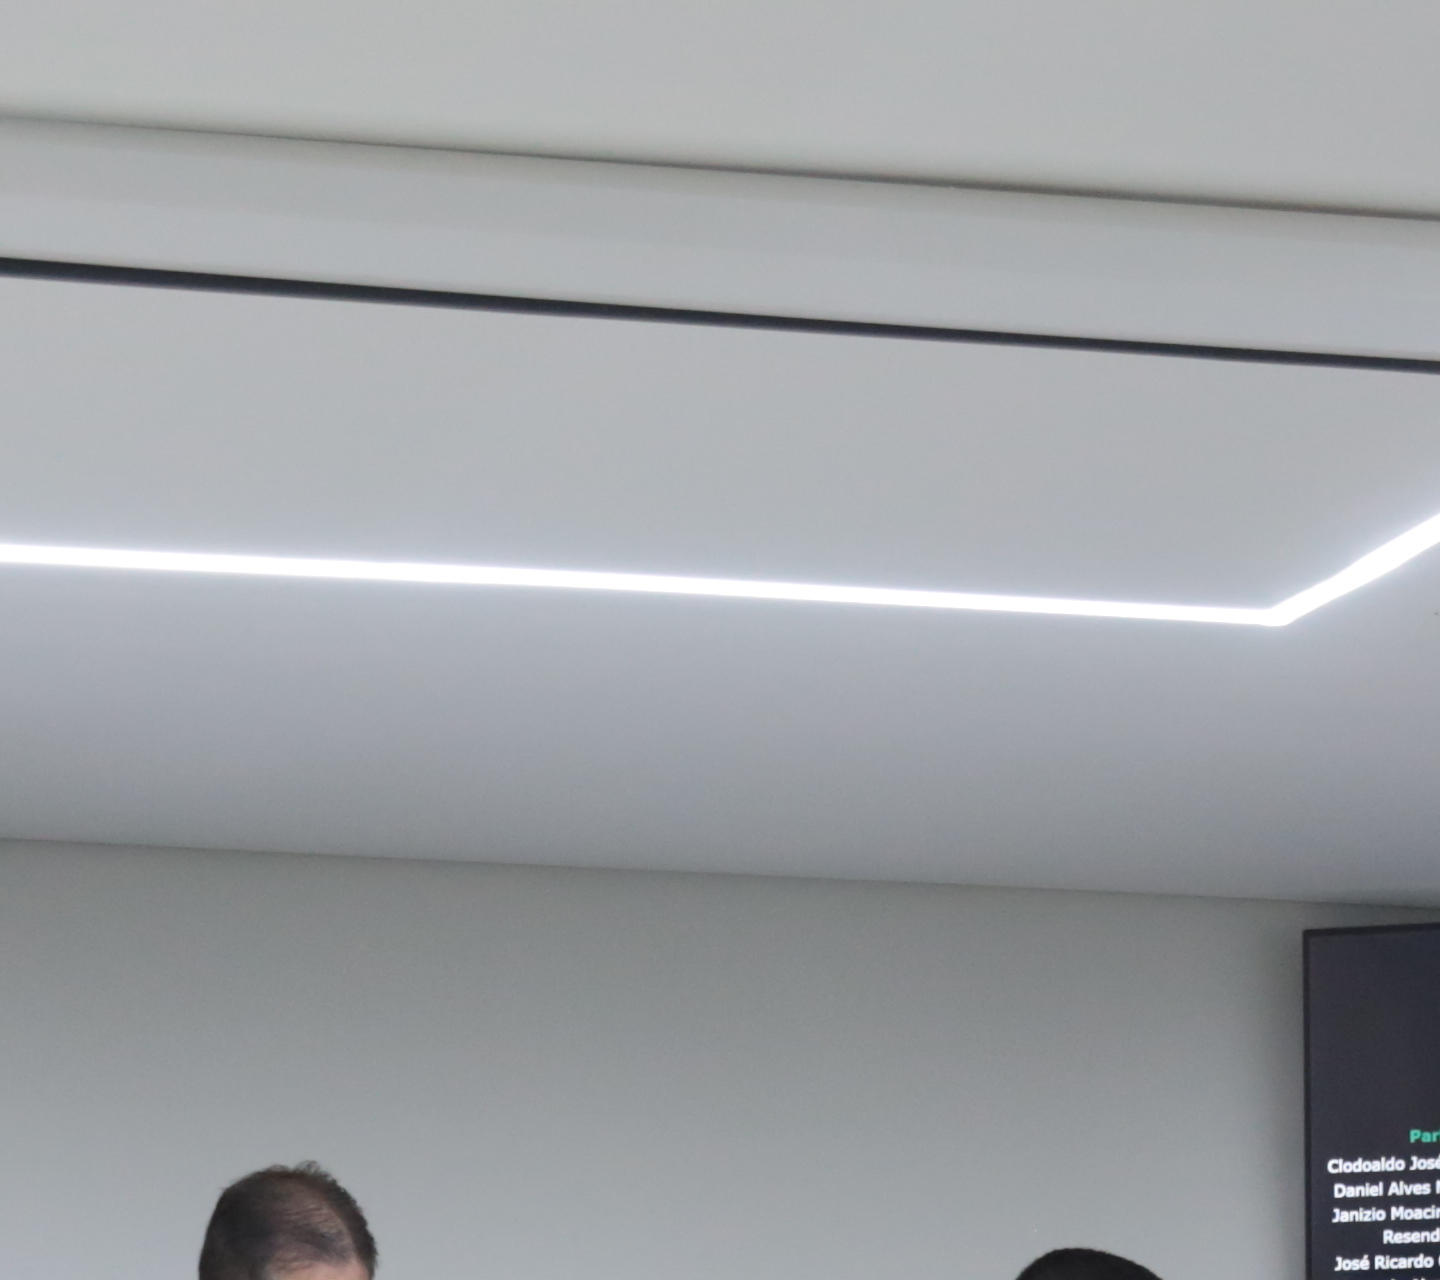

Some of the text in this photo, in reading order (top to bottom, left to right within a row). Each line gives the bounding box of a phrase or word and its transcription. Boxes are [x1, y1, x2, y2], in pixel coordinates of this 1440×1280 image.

[1327, 1157, 1405, 1173] Clodoaldo
[1334, 1182, 1383, 1198] Daniel
[1388, 1181, 1431, 1196] Alves
[1332, 1207, 1386, 1223] Janizio
[1335, 1255, 1370, 1271] José
[1375, 1254, 1434, 1269] Ricardo
